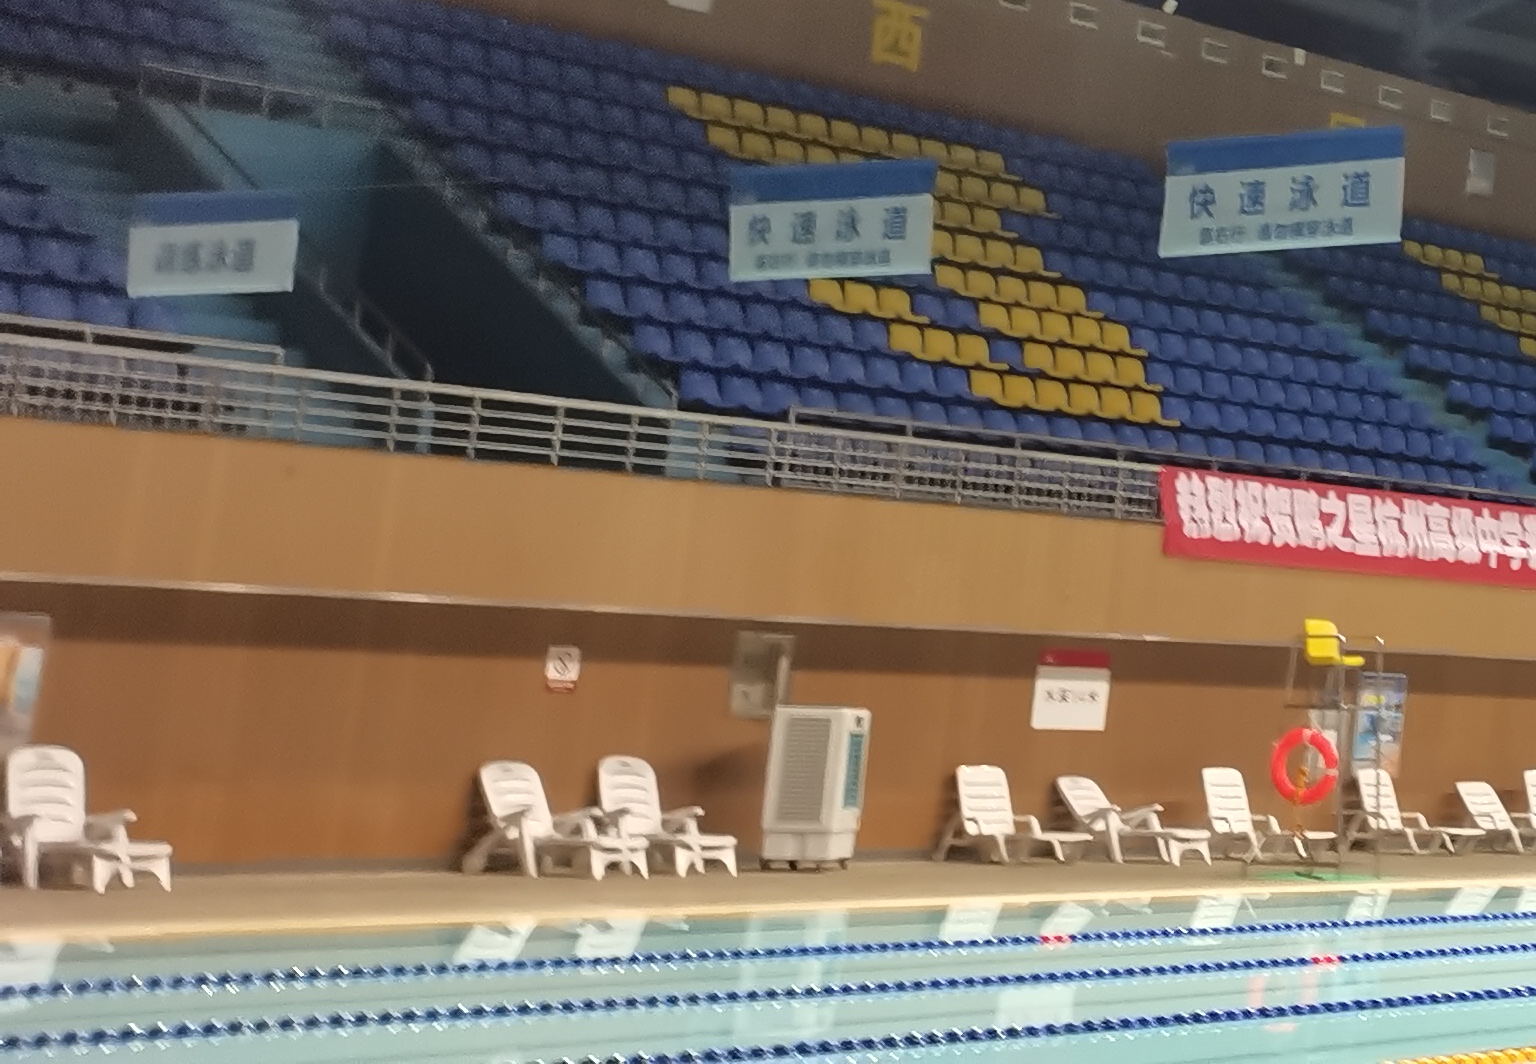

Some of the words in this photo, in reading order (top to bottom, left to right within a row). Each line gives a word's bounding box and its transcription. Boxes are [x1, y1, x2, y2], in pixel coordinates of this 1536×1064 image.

[1189, 170, 1372, 220] 快速泳道
[748, 206, 908, 245] 快速泳道
